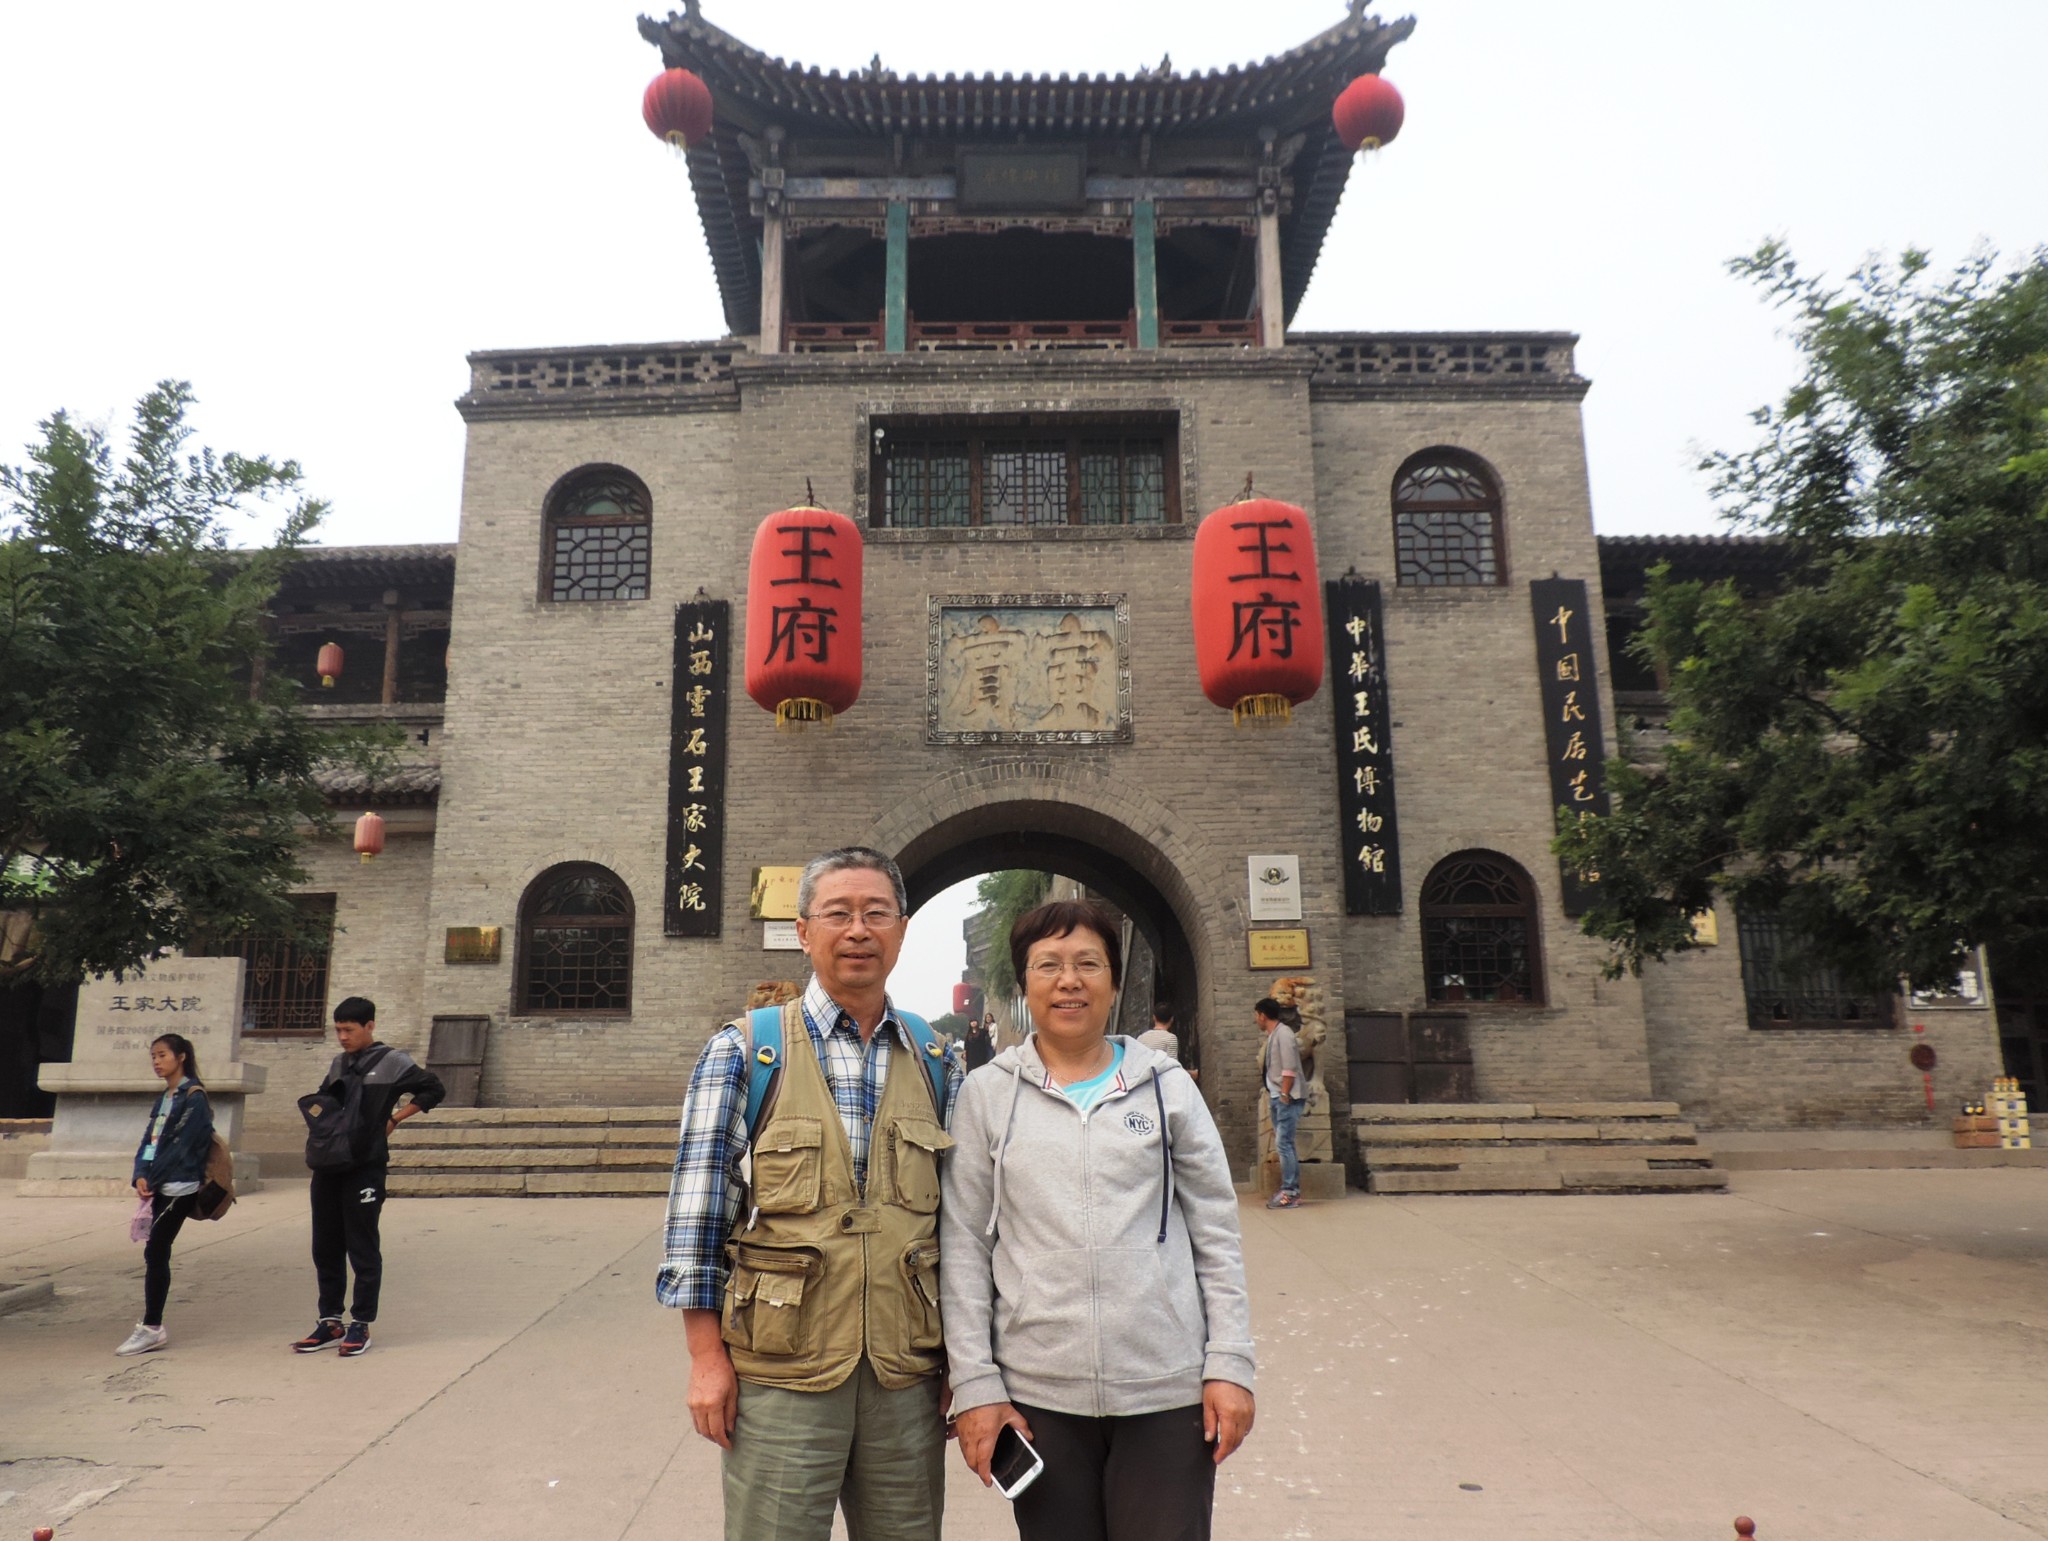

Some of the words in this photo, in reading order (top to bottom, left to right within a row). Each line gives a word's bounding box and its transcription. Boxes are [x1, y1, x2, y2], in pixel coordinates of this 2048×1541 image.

[763, 524, 842, 666] 王府
[1227, 518, 1302, 662] 王府
[1549, 606, 1601, 883] 中国民居艺
[109, 995, 202, 1012] 王家大院
[1129, 1118, 1149, 1130] NYC
